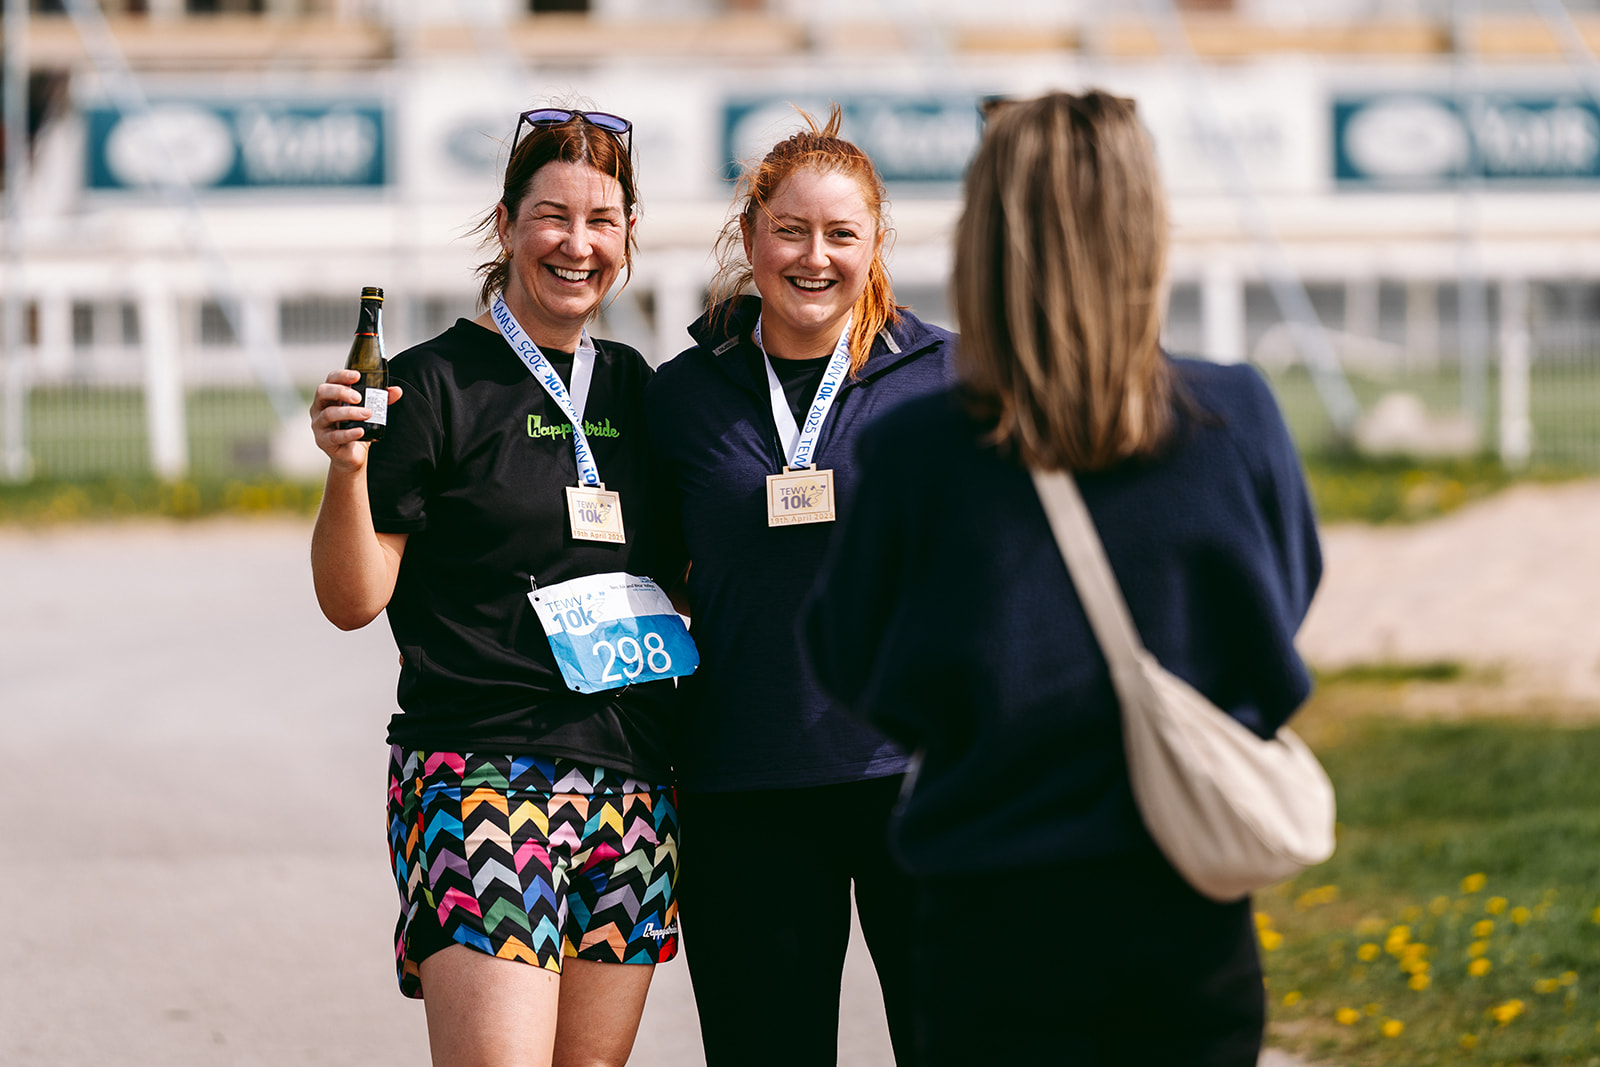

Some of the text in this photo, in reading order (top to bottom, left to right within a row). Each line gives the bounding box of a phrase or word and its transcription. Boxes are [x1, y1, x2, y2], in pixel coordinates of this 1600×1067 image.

[494, 306, 520, 342] TEWV
[517, 341, 547, 372] 2025
[544, 372, 566, 398] 10k
[817, 381, 836, 401] 10k
[527, 414, 620, 441] Happtride
[805, 405, 825, 434] 2025
[794, 438, 813, 468] TEW
[583, 467, 598, 486] 10
[780, 486, 808, 496] TEWV
[780, 494, 813, 510] 10k
[576, 500, 598, 510] TEWV
[578, 509, 603, 524] 10k
[770, 517, 788, 525] 19th
[791, 515, 812, 524] April
[545, 594, 583, 614] TEWV
[552, 606, 597, 631] 10k
[592, 632, 672, 683] 298
